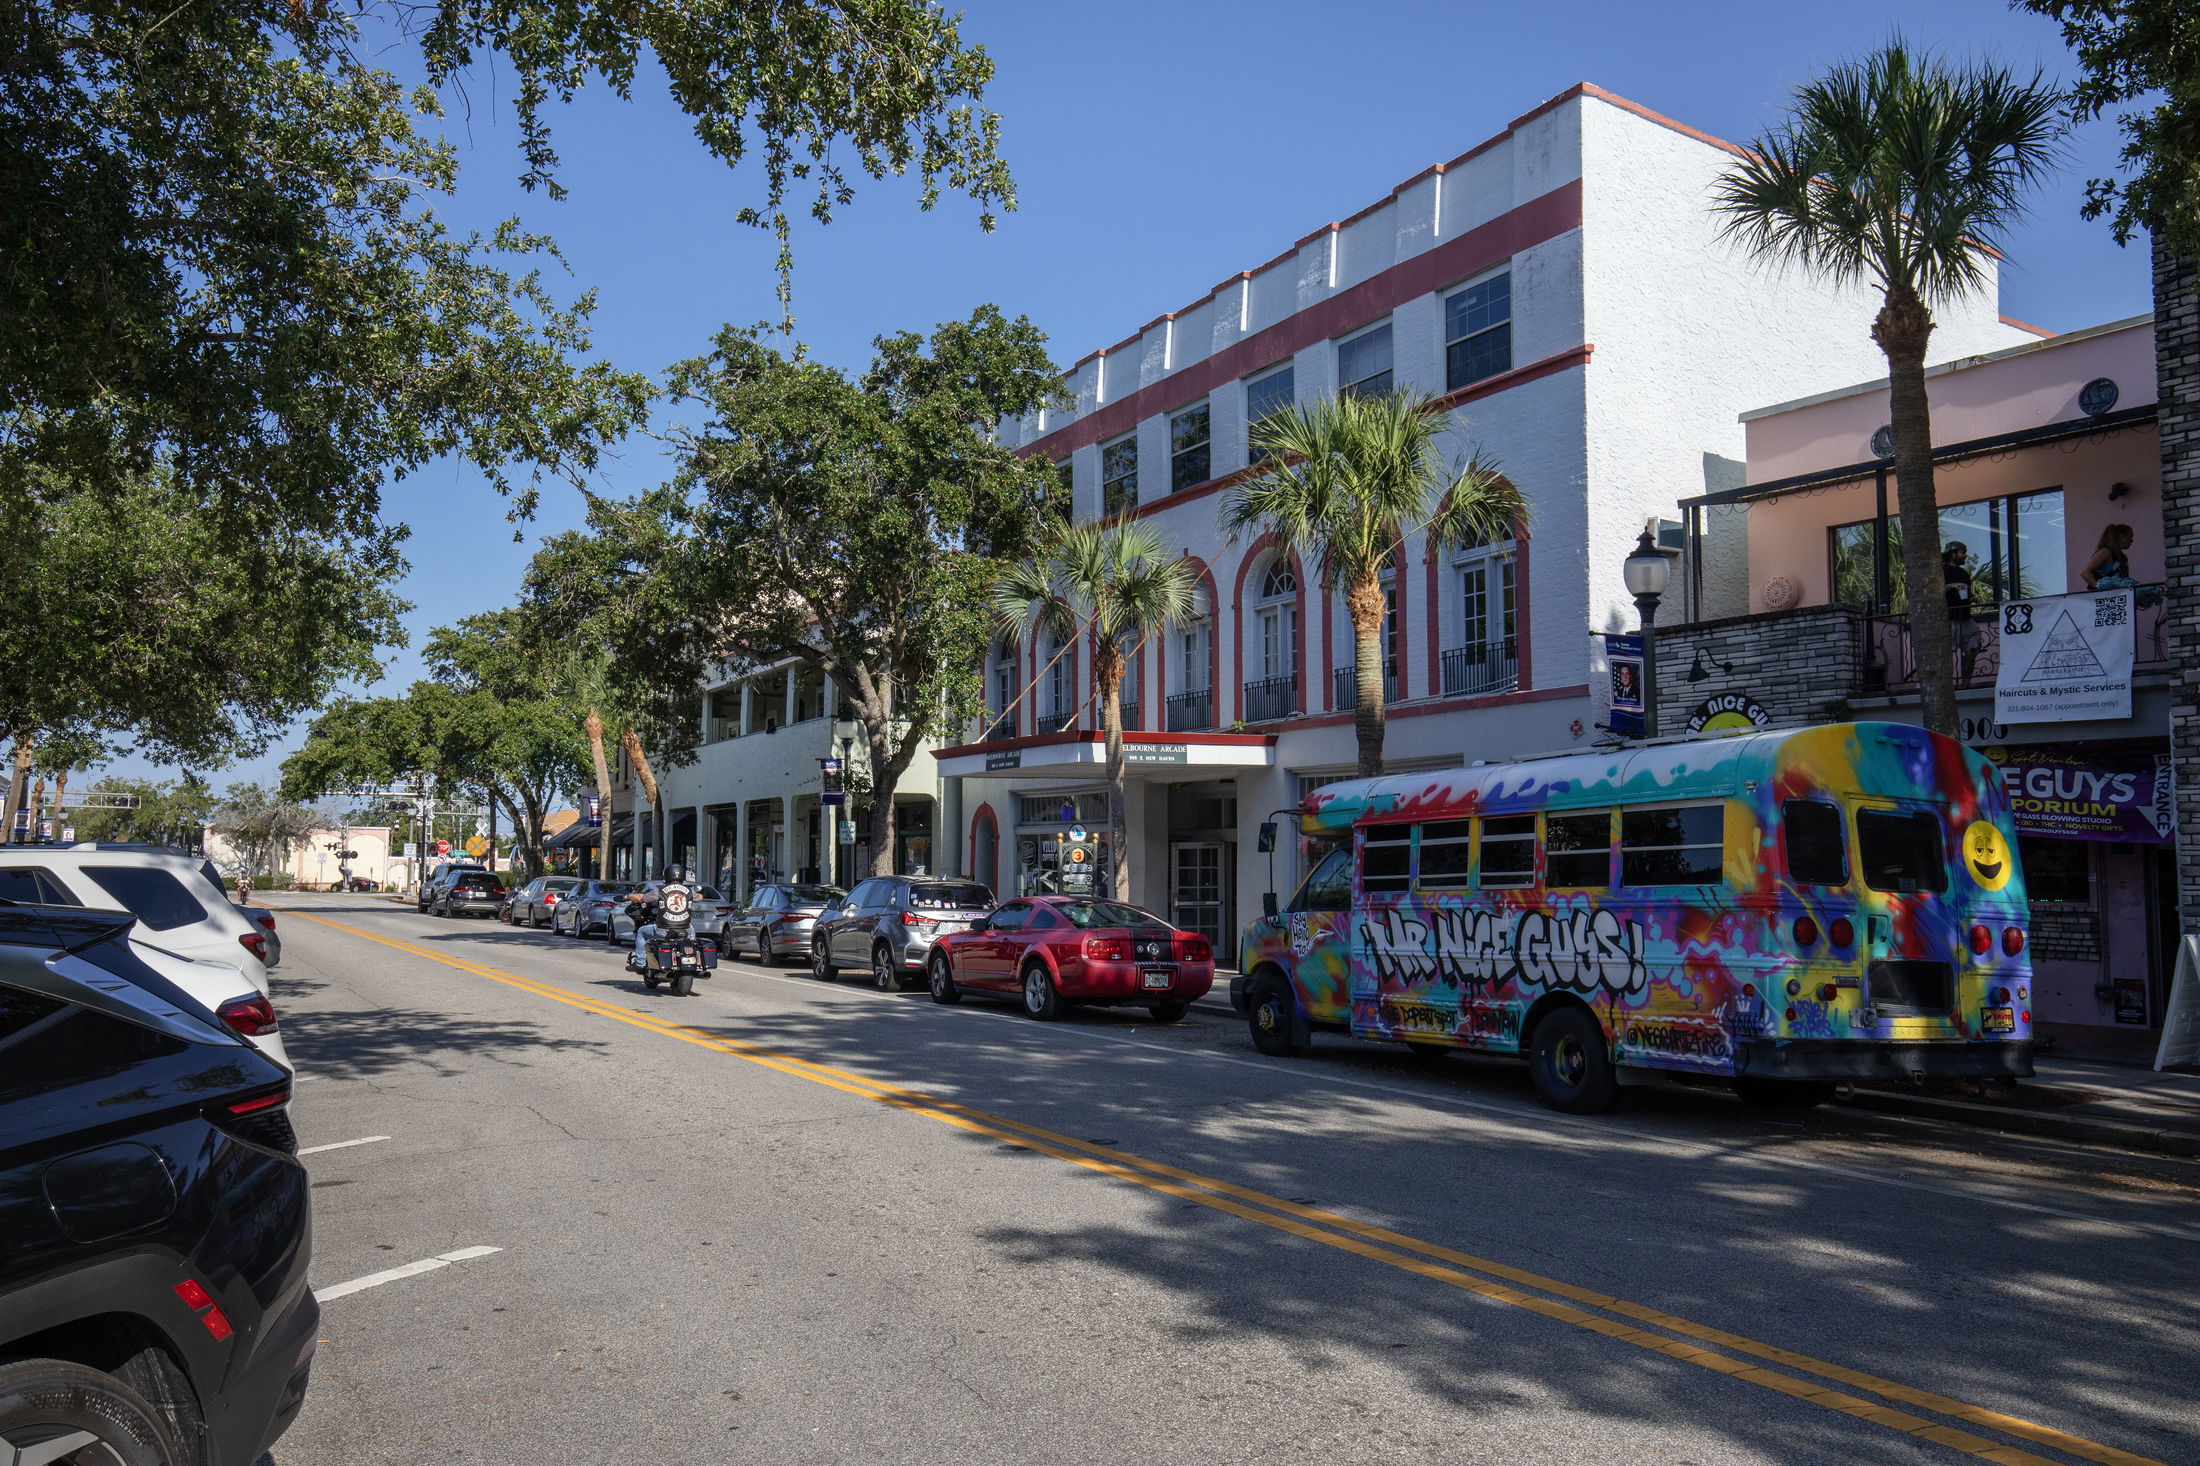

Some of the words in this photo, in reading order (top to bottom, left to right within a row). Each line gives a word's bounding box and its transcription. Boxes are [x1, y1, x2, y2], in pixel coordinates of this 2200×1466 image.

[1999, 688, 2037, 698] Haircuts
[2040, 687, 2047, 696] &
[2050, 685, 2081, 697] Mystic
[2084, 683, 2126, 693] Services
[1707, 695, 1746, 715] NICE
[2007, 703, 2053, 712] 321-804-1067
[2054, 701, 2100, 711] (appointment
[2101, 700, 2119, 708] only)
[1122, 744, 1157, 753] ELBOURNE
[1160, 745, 1187, 753] ARCADE
[2025, 767, 2137, 803] GUYS
[2156, 754, 2171, 830] ENTRANCE
[2010, 798, 2117, 817] PORIUM
[2022, 813, 2041, 821] GLASS
[2041, 814, 2081, 823] BLOWING
[2081, 816, 2112, 825] STUDIO
[2065, 823, 2099, 831] NOVELTY
[1074, 851, 1082, 861] 3
[1362, 909, 1438, 986] MR
